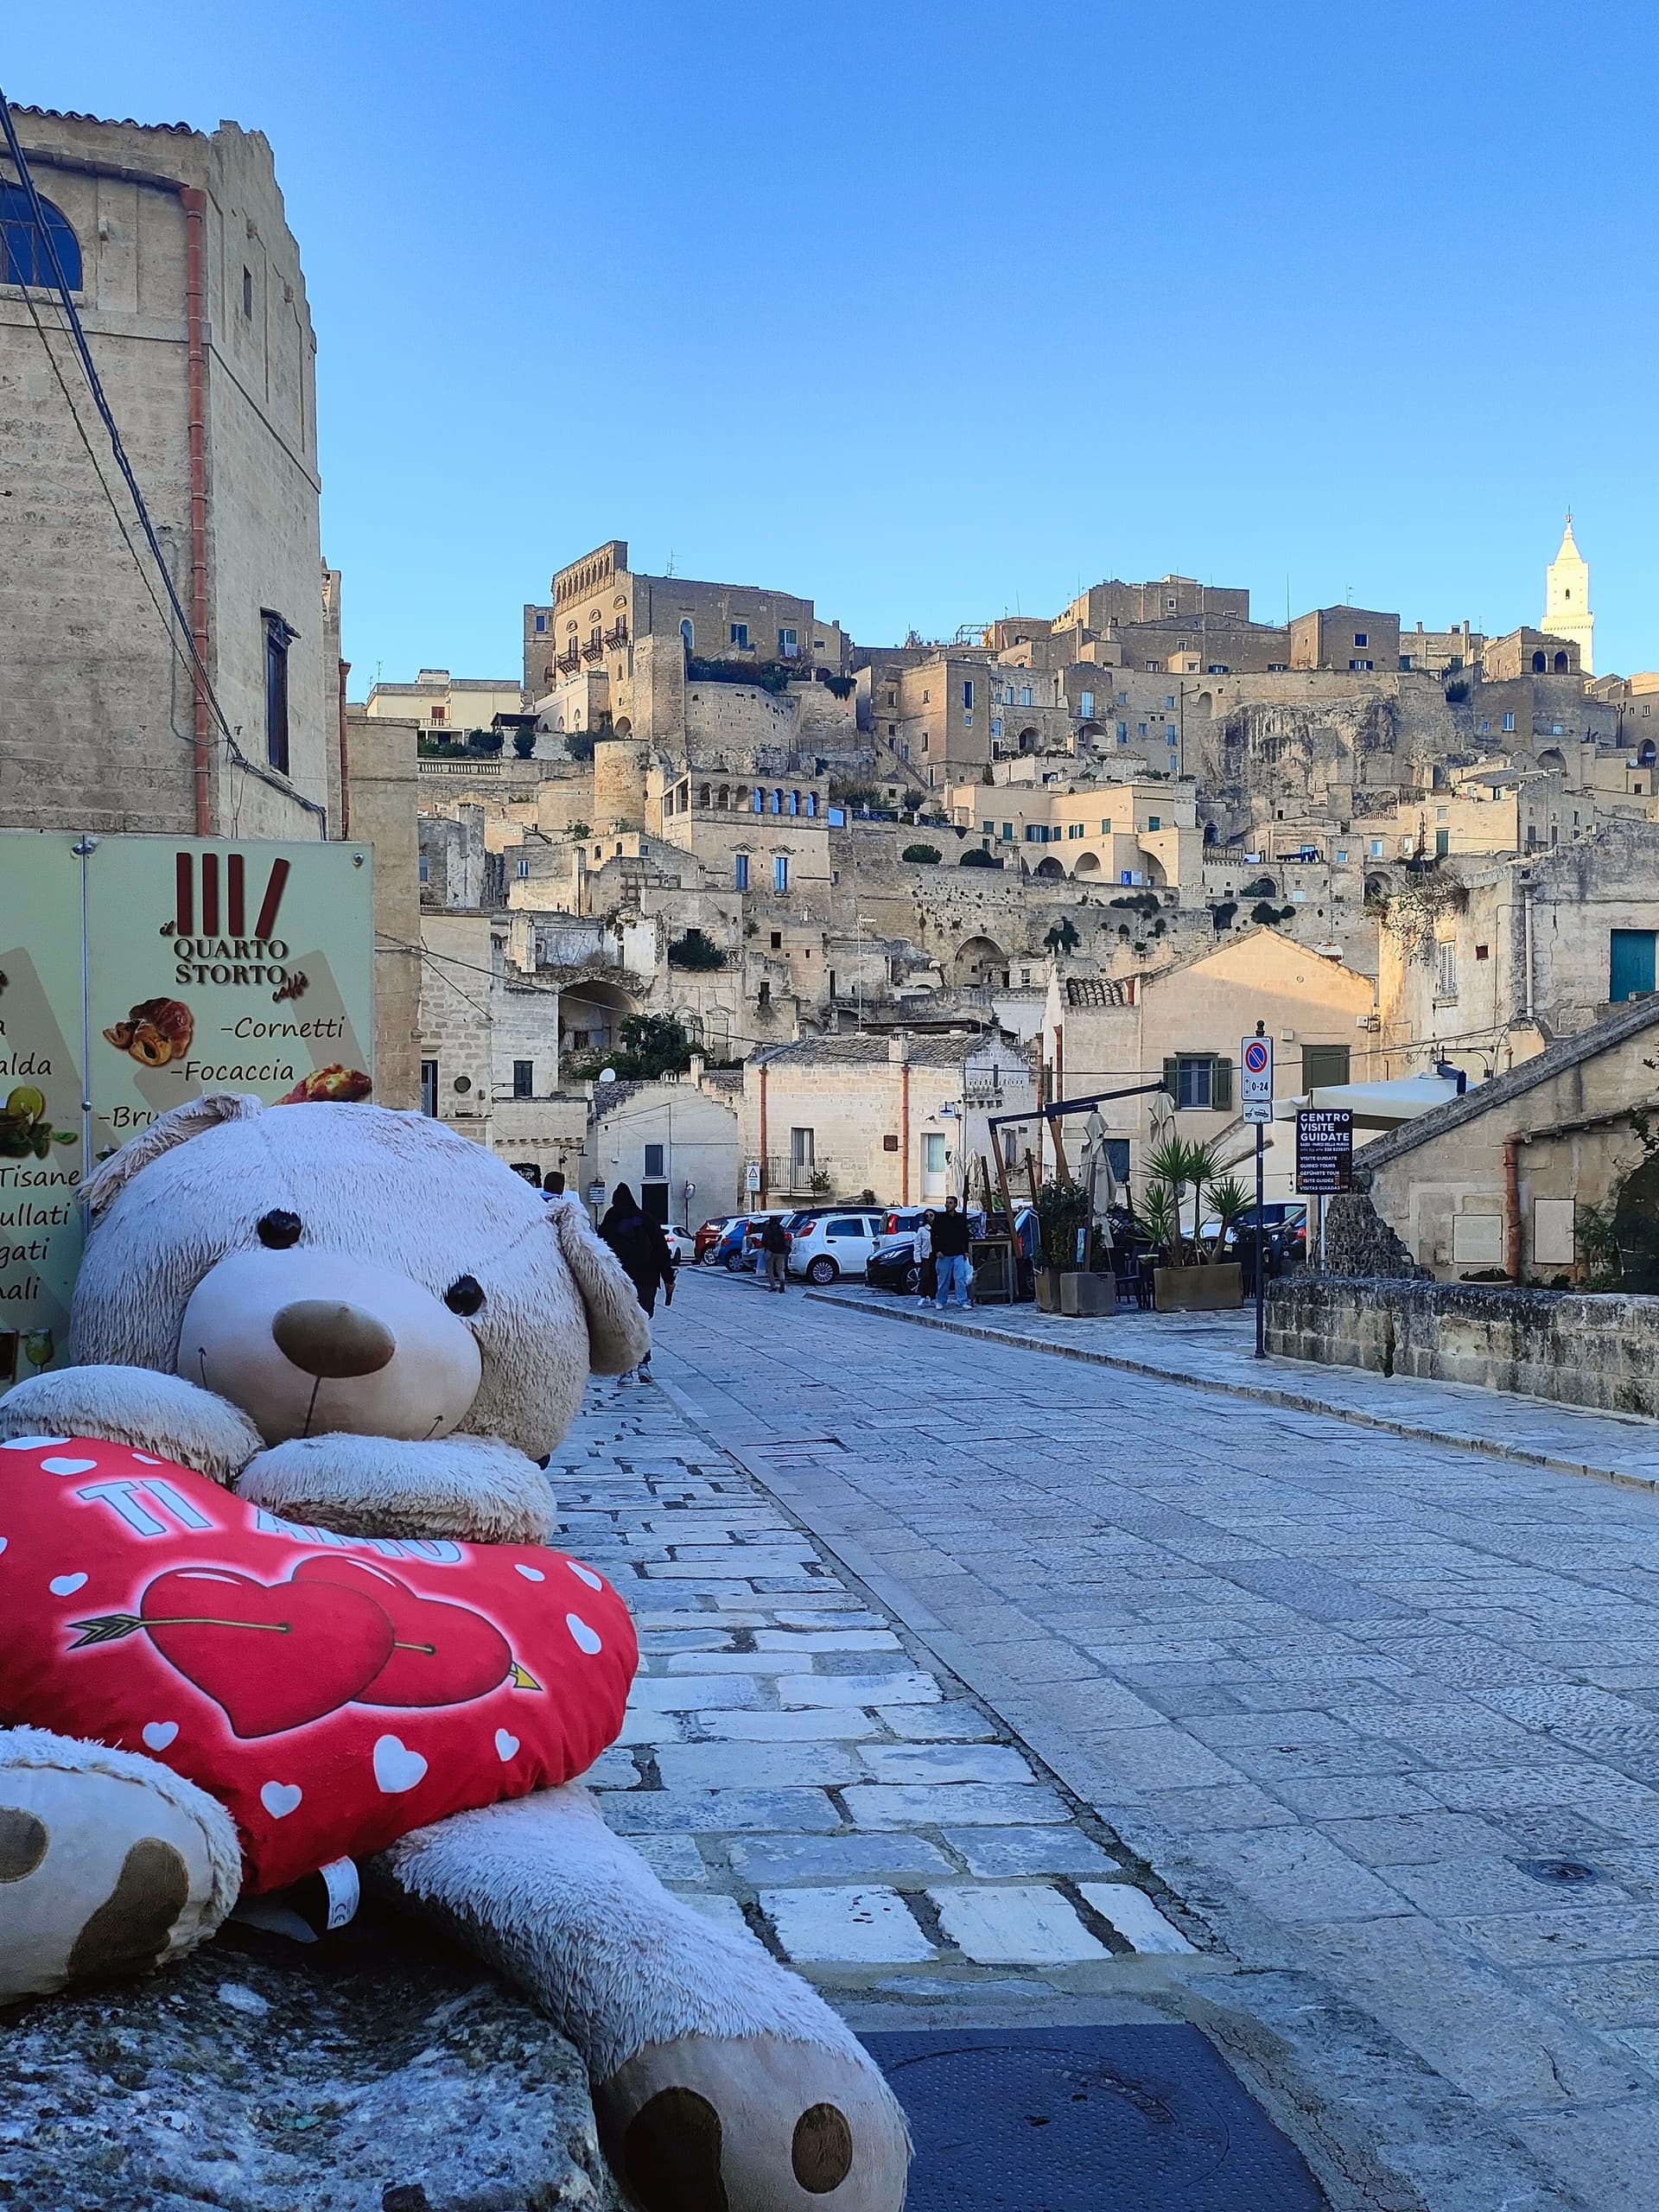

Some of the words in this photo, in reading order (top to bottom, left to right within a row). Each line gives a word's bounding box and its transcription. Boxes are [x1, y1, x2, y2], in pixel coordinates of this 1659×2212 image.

[159, 920, 175, 936] il
[174, 938, 288, 962] QUARTO
[175, 964, 287, 984] STORTO
[272, 971, 308, 1002] caffè
[1251, 1082, 1268, 1091] 0-24
[1300, 1113, 1350, 1122] CENTRO
[1300, 1122, 1335, 1132] VISITE
[1300, 1132, 1350, 1141] GUIDATE
[76, 1479, 213, 1537] TI
